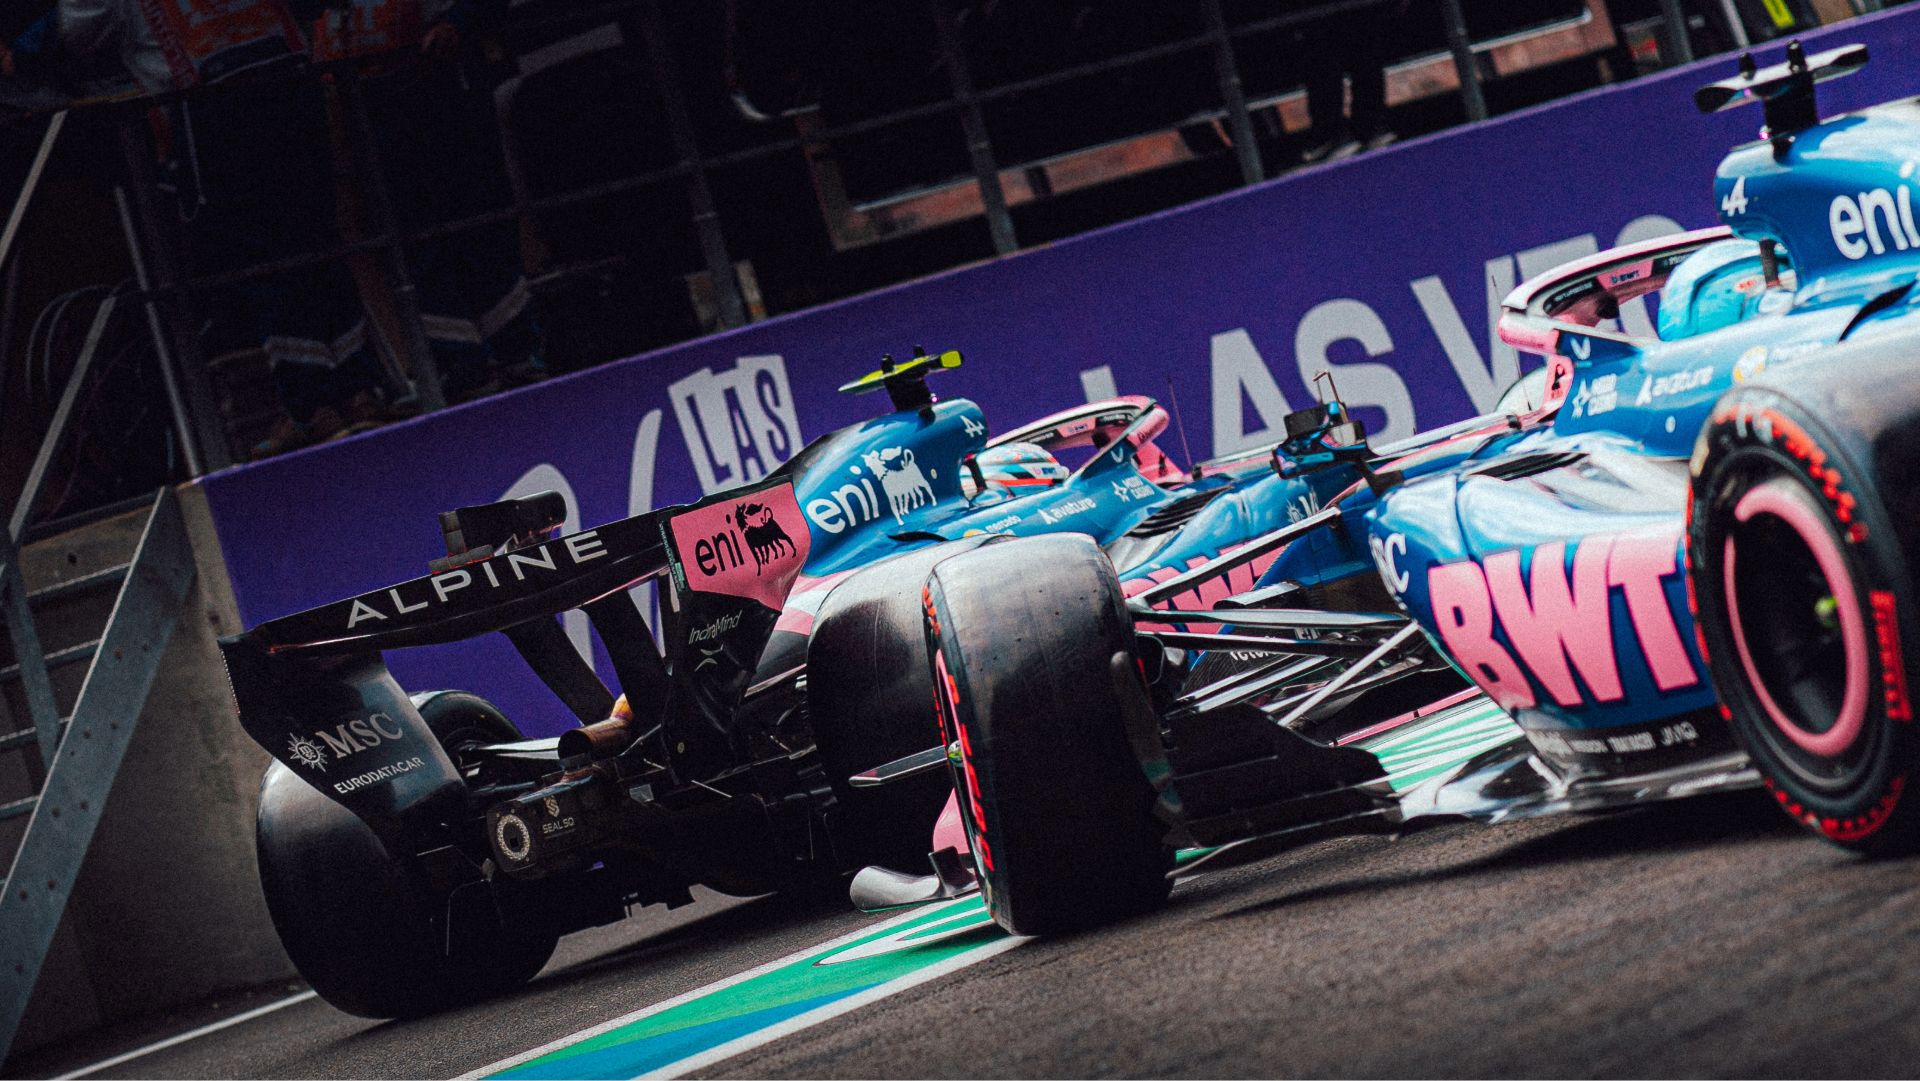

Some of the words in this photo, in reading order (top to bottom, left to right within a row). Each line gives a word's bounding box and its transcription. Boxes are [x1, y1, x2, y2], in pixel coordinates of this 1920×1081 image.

[1829, 160, 1920, 260] eni
[1081, 298, 1417, 461] AS
[685, 368, 792, 485] LAS
[806, 465, 880, 534] eni
[347, 530, 608, 629] ALPINE
[695, 514, 745, 577] eni
[688, 608, 743, 645] IndraMind
[1427, 524, 1699, 710] BWT
[315, 712, 403, 759] MSC
[333, 756, 426, 794] EURODATACAR
